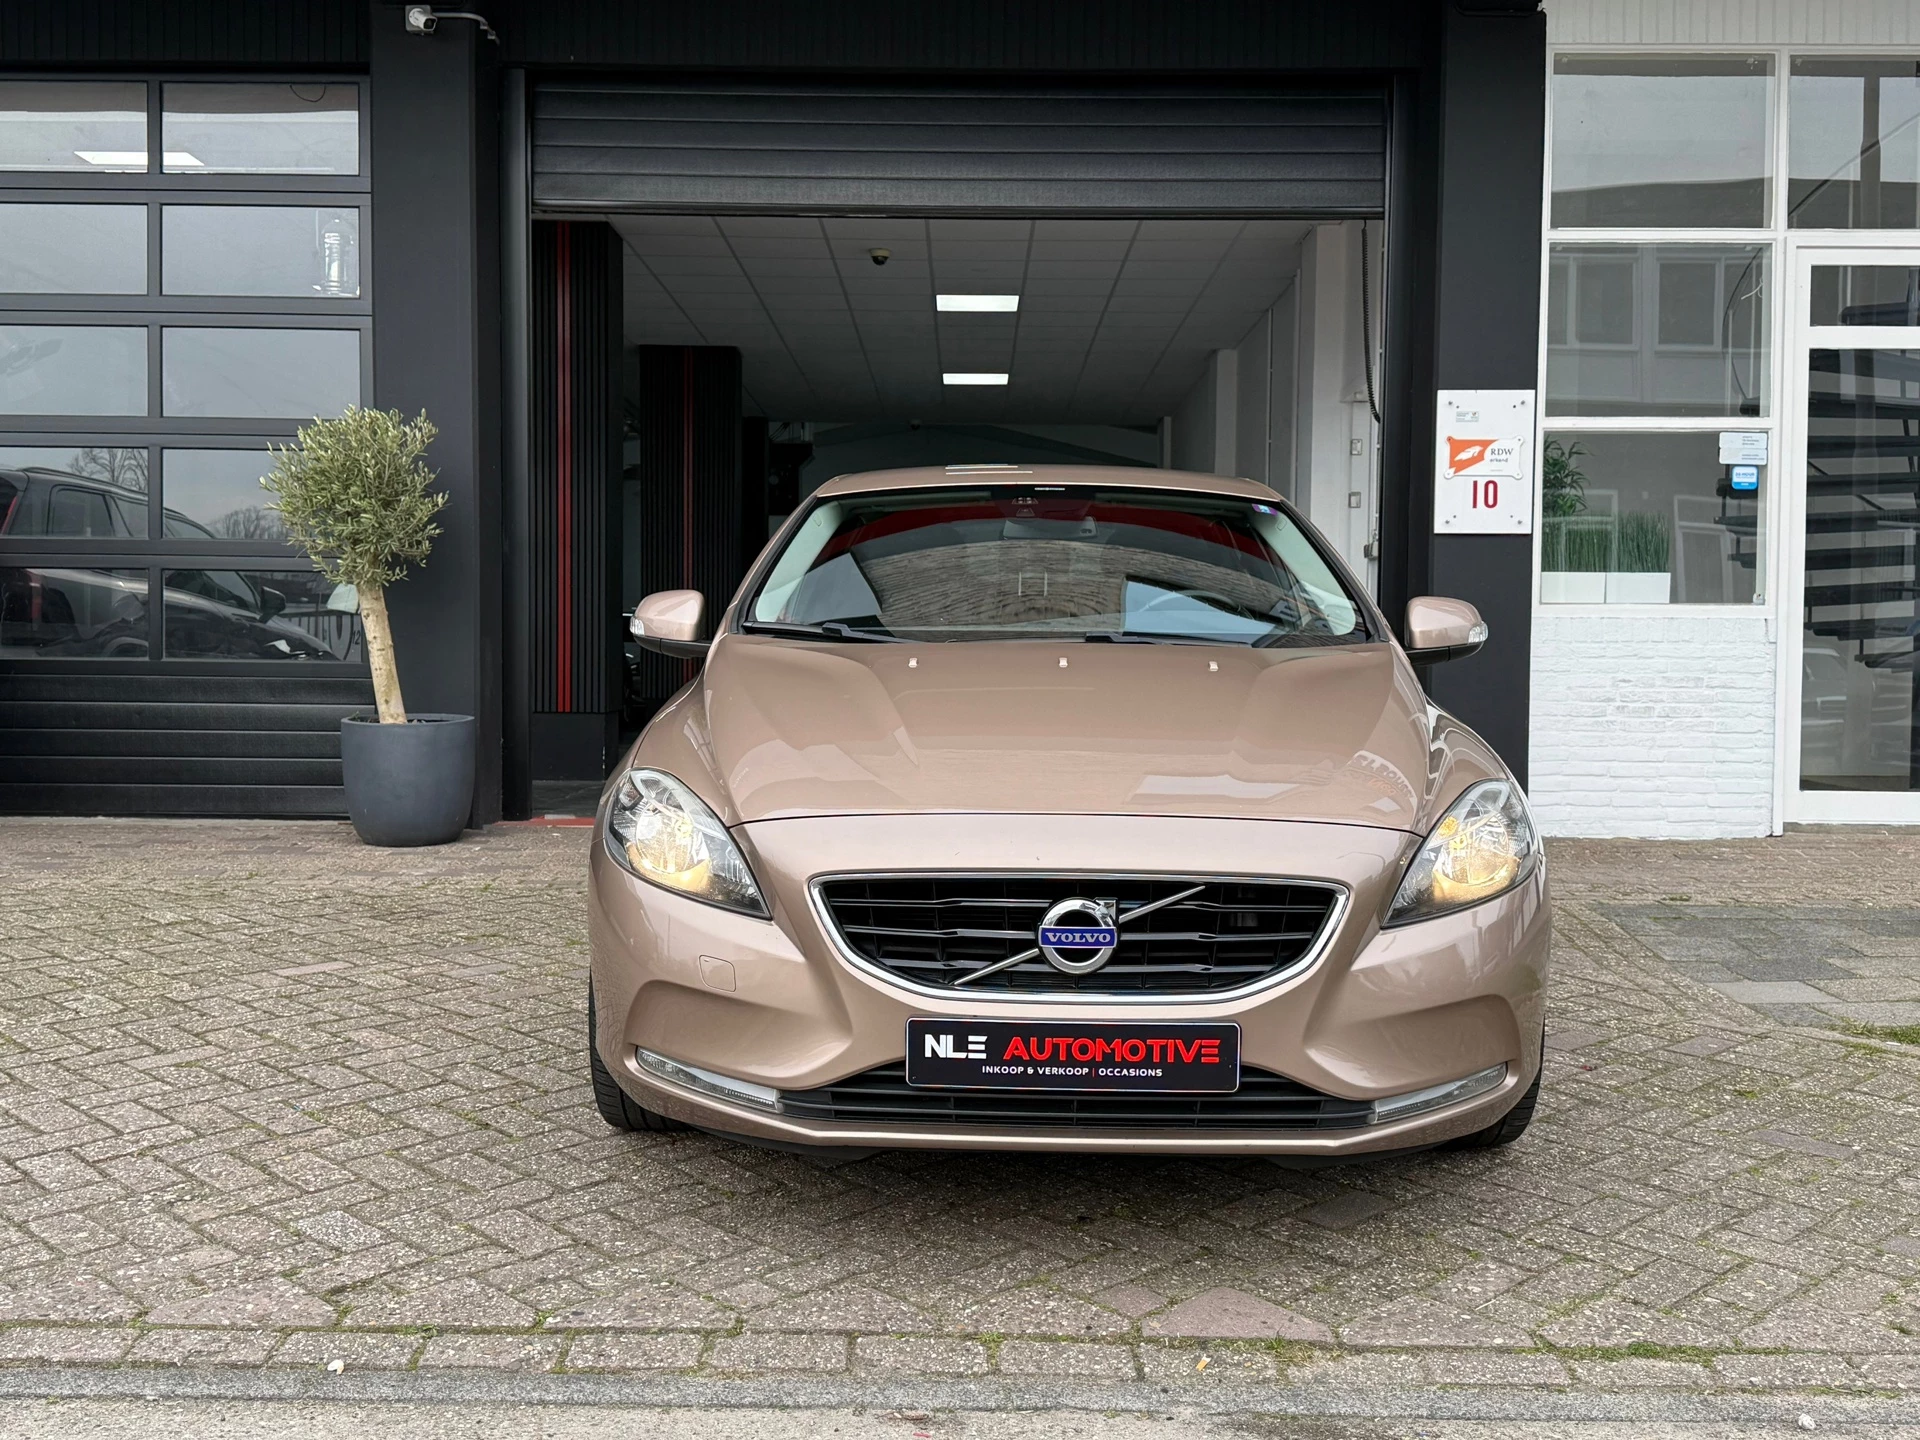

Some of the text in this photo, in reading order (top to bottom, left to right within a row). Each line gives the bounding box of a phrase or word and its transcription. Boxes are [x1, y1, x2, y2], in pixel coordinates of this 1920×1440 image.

[1490, 447, 1514, 456] RDW
[1472, 479, 1498, 509] 10
[1045, 932, 1111, 943] VOLVO
[924, 1033, 1221, 1064] NLE AUTOMOTIVE
[982, 1065, 1163, 1077] INKOOP & VERKOOP OCCASIONS
